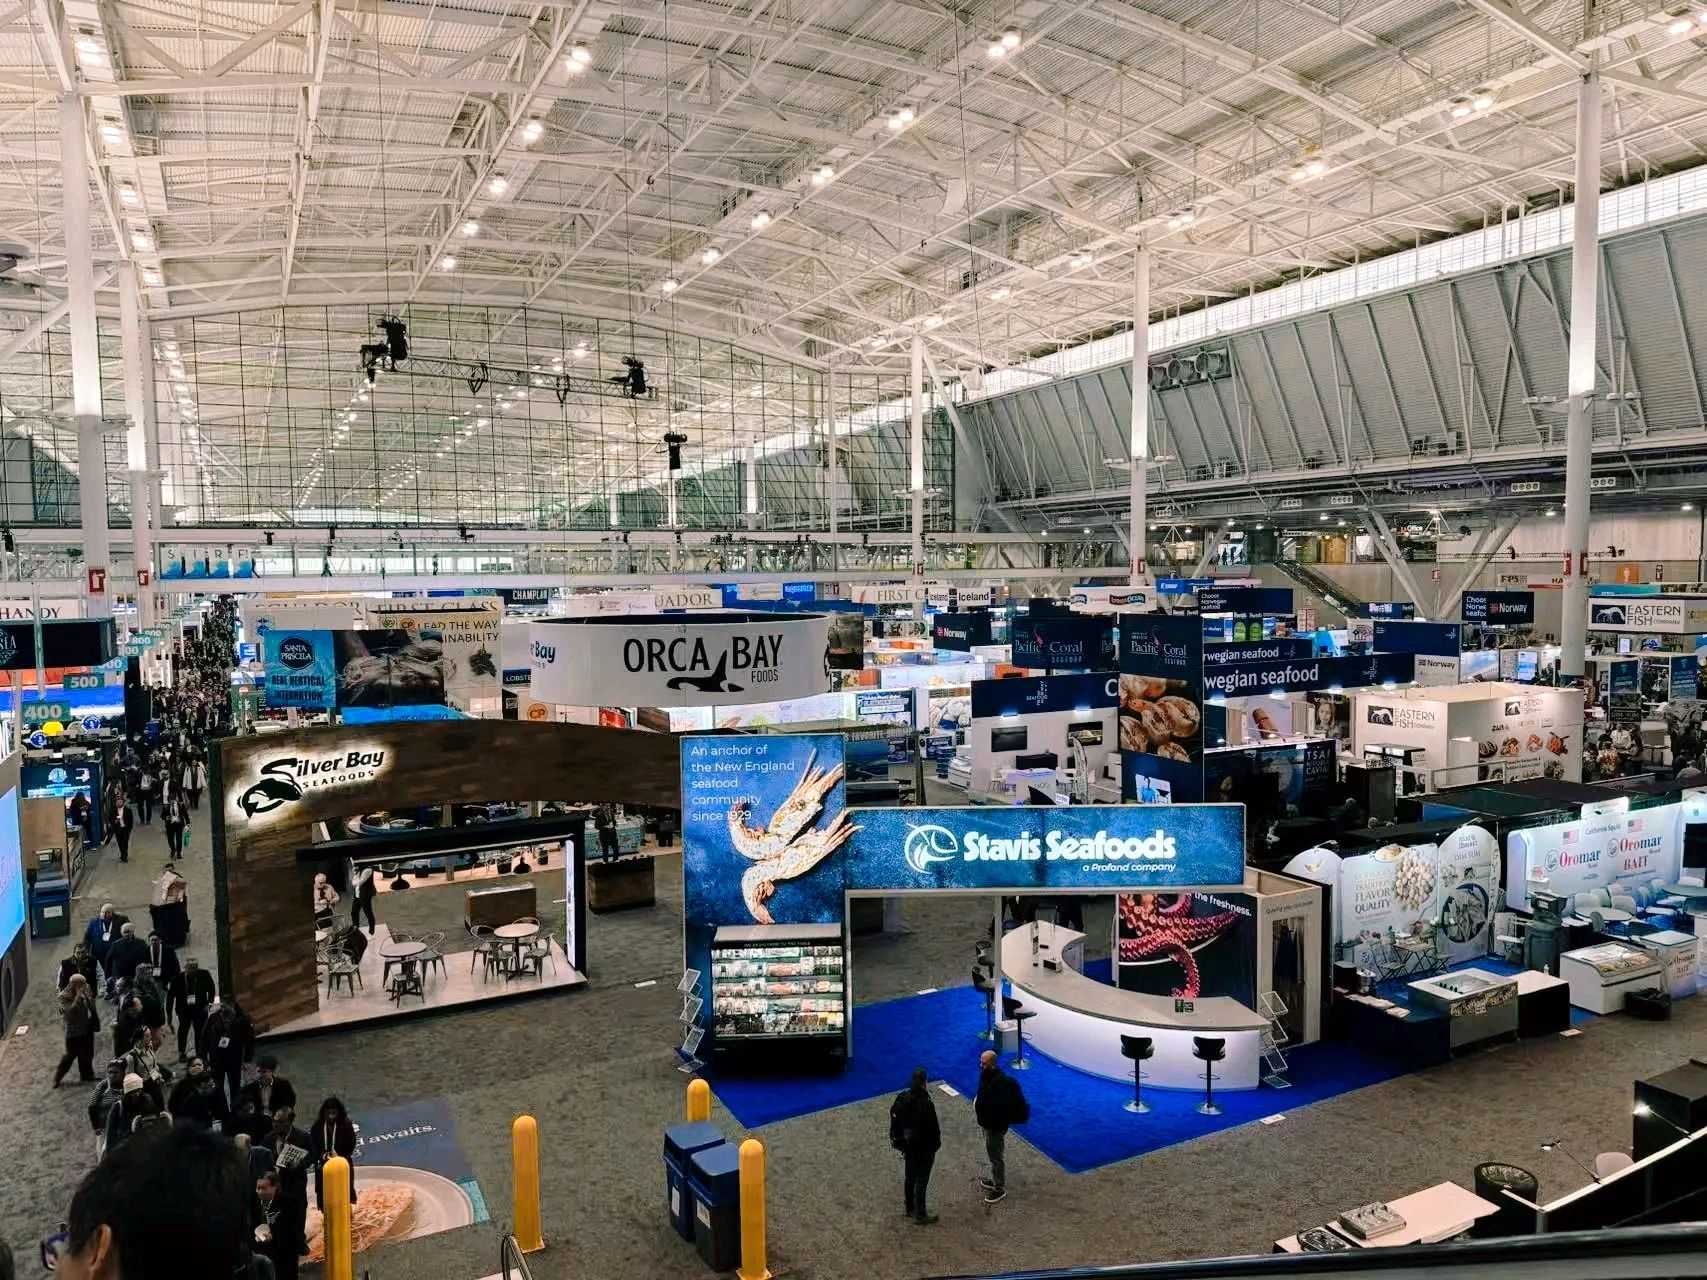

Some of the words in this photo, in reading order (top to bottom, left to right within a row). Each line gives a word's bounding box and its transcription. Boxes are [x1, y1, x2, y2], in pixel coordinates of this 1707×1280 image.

[1499, 602, 1528, 614] Norway
[1628, 605, 1681, 617] EASTERN
[449, 621, 470, 630] THE
[473, 620, 499, 630] WAY
[1628, 616, 1653, 627] FISH
[943, 628, 967, 640] Norway
[284, 644, 307, 653] SANTA
[535, 641, 556, 663] Bay
[623, 637, 712, 673] ORCA
[732, 634, 784, 670] BAY
[1015, 640, 1042, 654] Pacific
[1049, 641, 1084, 654] Coral
[1131, 641, 1159, 655] Pacific
[1163, 643, 1188, 656] Coral
[1241, 646, 1280, 660] seafood
[1426, 659, 1456, 670] Norway
[751, 669, 779, 684] FOODS
[1260, 663, 1319, 685] seafood
[71, 675, 99, 688] 500
[25, 704, 62, 719] 400
[1394, 708, 1435, 721] EASTERN
[1394, 718, 1414, 729] FISH
[691, 746, 708, 756] An
[711, 745, 753, 756] anchor
[755, 744, 768, 755] of
[261, 757, 343, 782] Silver
[346, 751, 385, 768] Bay
[691, 762, 712, 773] the
[715, 762, 742, 772] New
[745, 761, 795, 774] England
[302, 770, 375, 789] SEAFOODS
[691, 778, 738, 789] seafood
[692, 794, 762, 806] community
[692, 811, 724, 822] since
[726, 810, 752, 821] 1929
[963, 831, 1042, 862] Stavis
[1045, 829, 1177, 861] Seafoods
[1619, 836, 1663, 852] Oromar
[1559, 850, 1602, 868] Oromar
[1623, 856, 1649, 871] BAIT
[1091, 863, 1129, 872] Profand
[1131, 863, 1177, 873] company
[1355, 887, 1391, 903] FLAVOR
[1209, 895, 1252, 917] freshness.
[1354, 899, 1391, 914] QUALITY
[368, 1124, 437, 1144] awaits.
